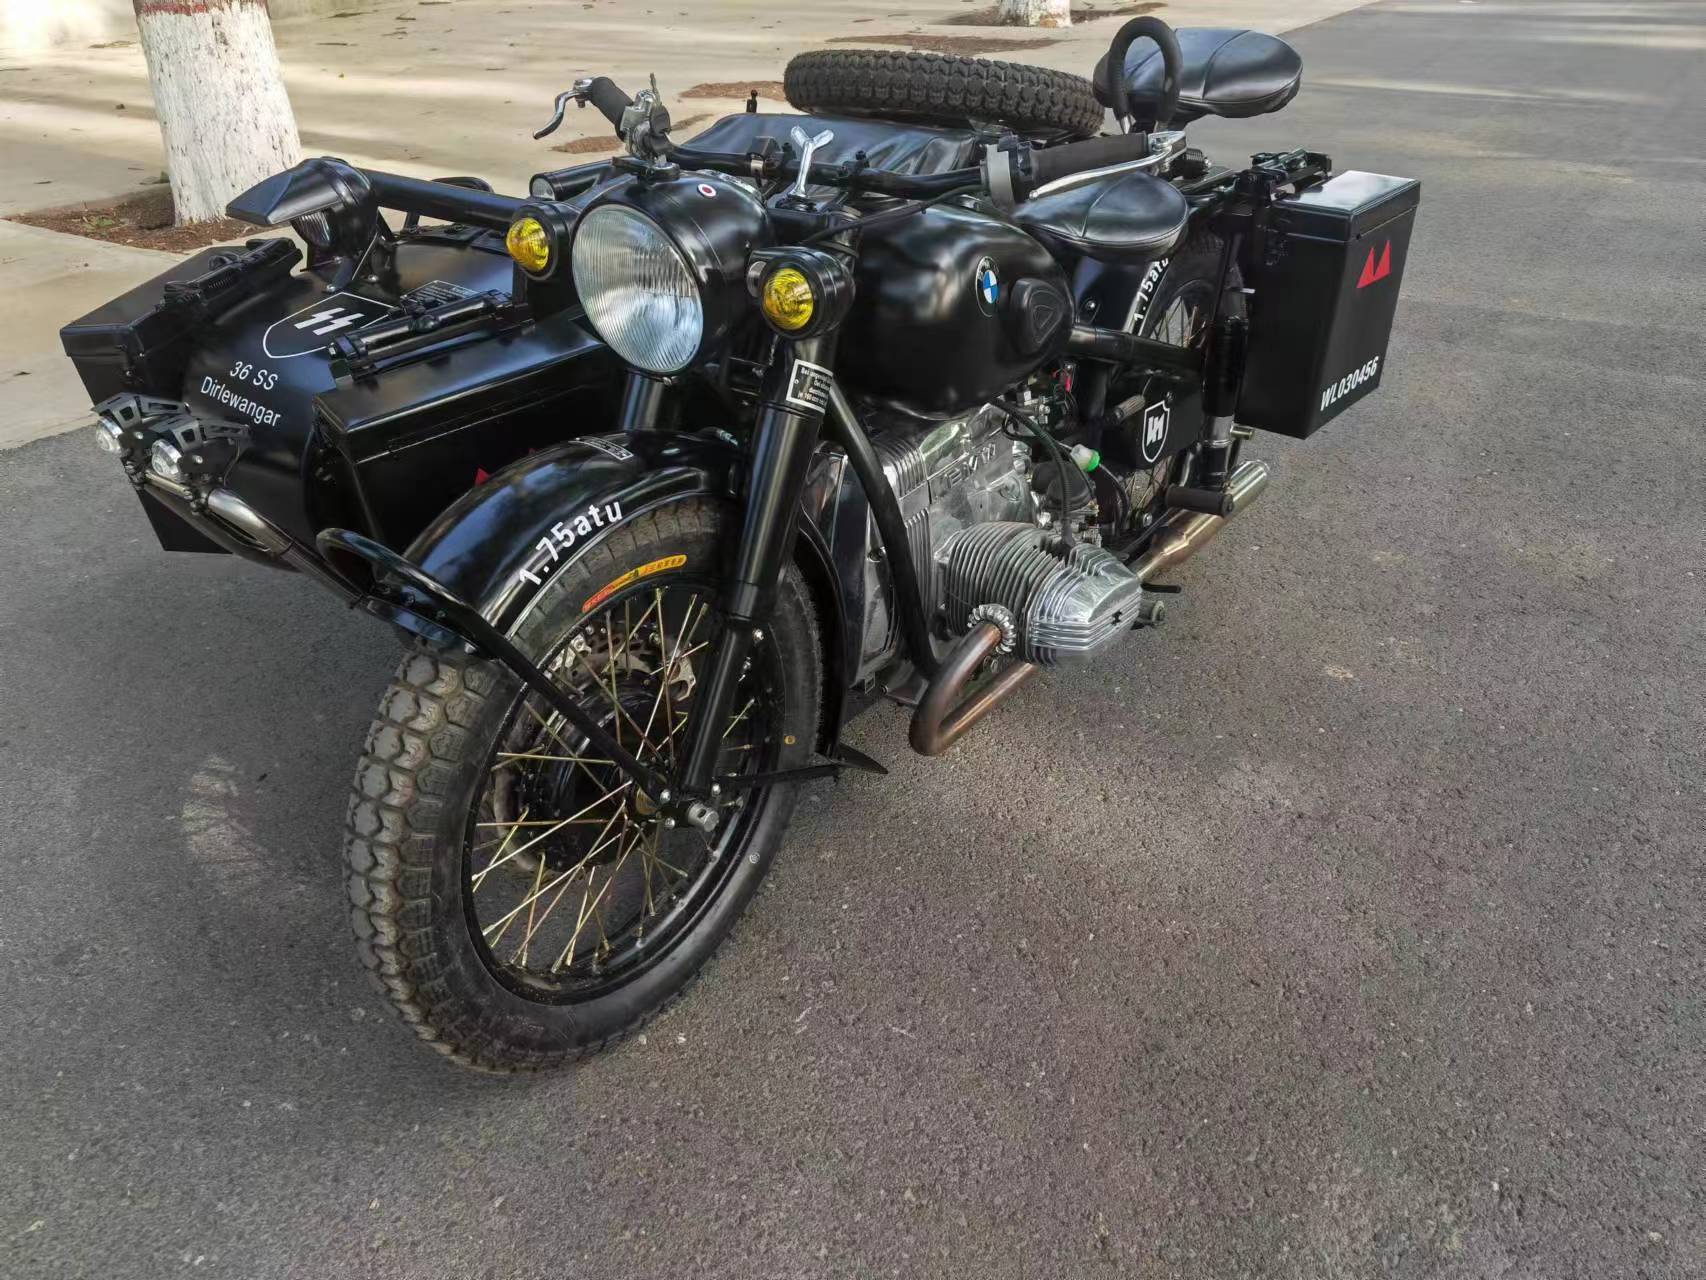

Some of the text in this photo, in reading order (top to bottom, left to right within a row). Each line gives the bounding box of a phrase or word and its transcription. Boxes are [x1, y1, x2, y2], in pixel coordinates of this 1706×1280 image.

[200, 376, 282, 427] Dirlewangar
[229, 361, 279, 391] 36 SS
[1320, 355, 1379, 412] WL030456
[518, 501, 624, 586] 1.75atu
